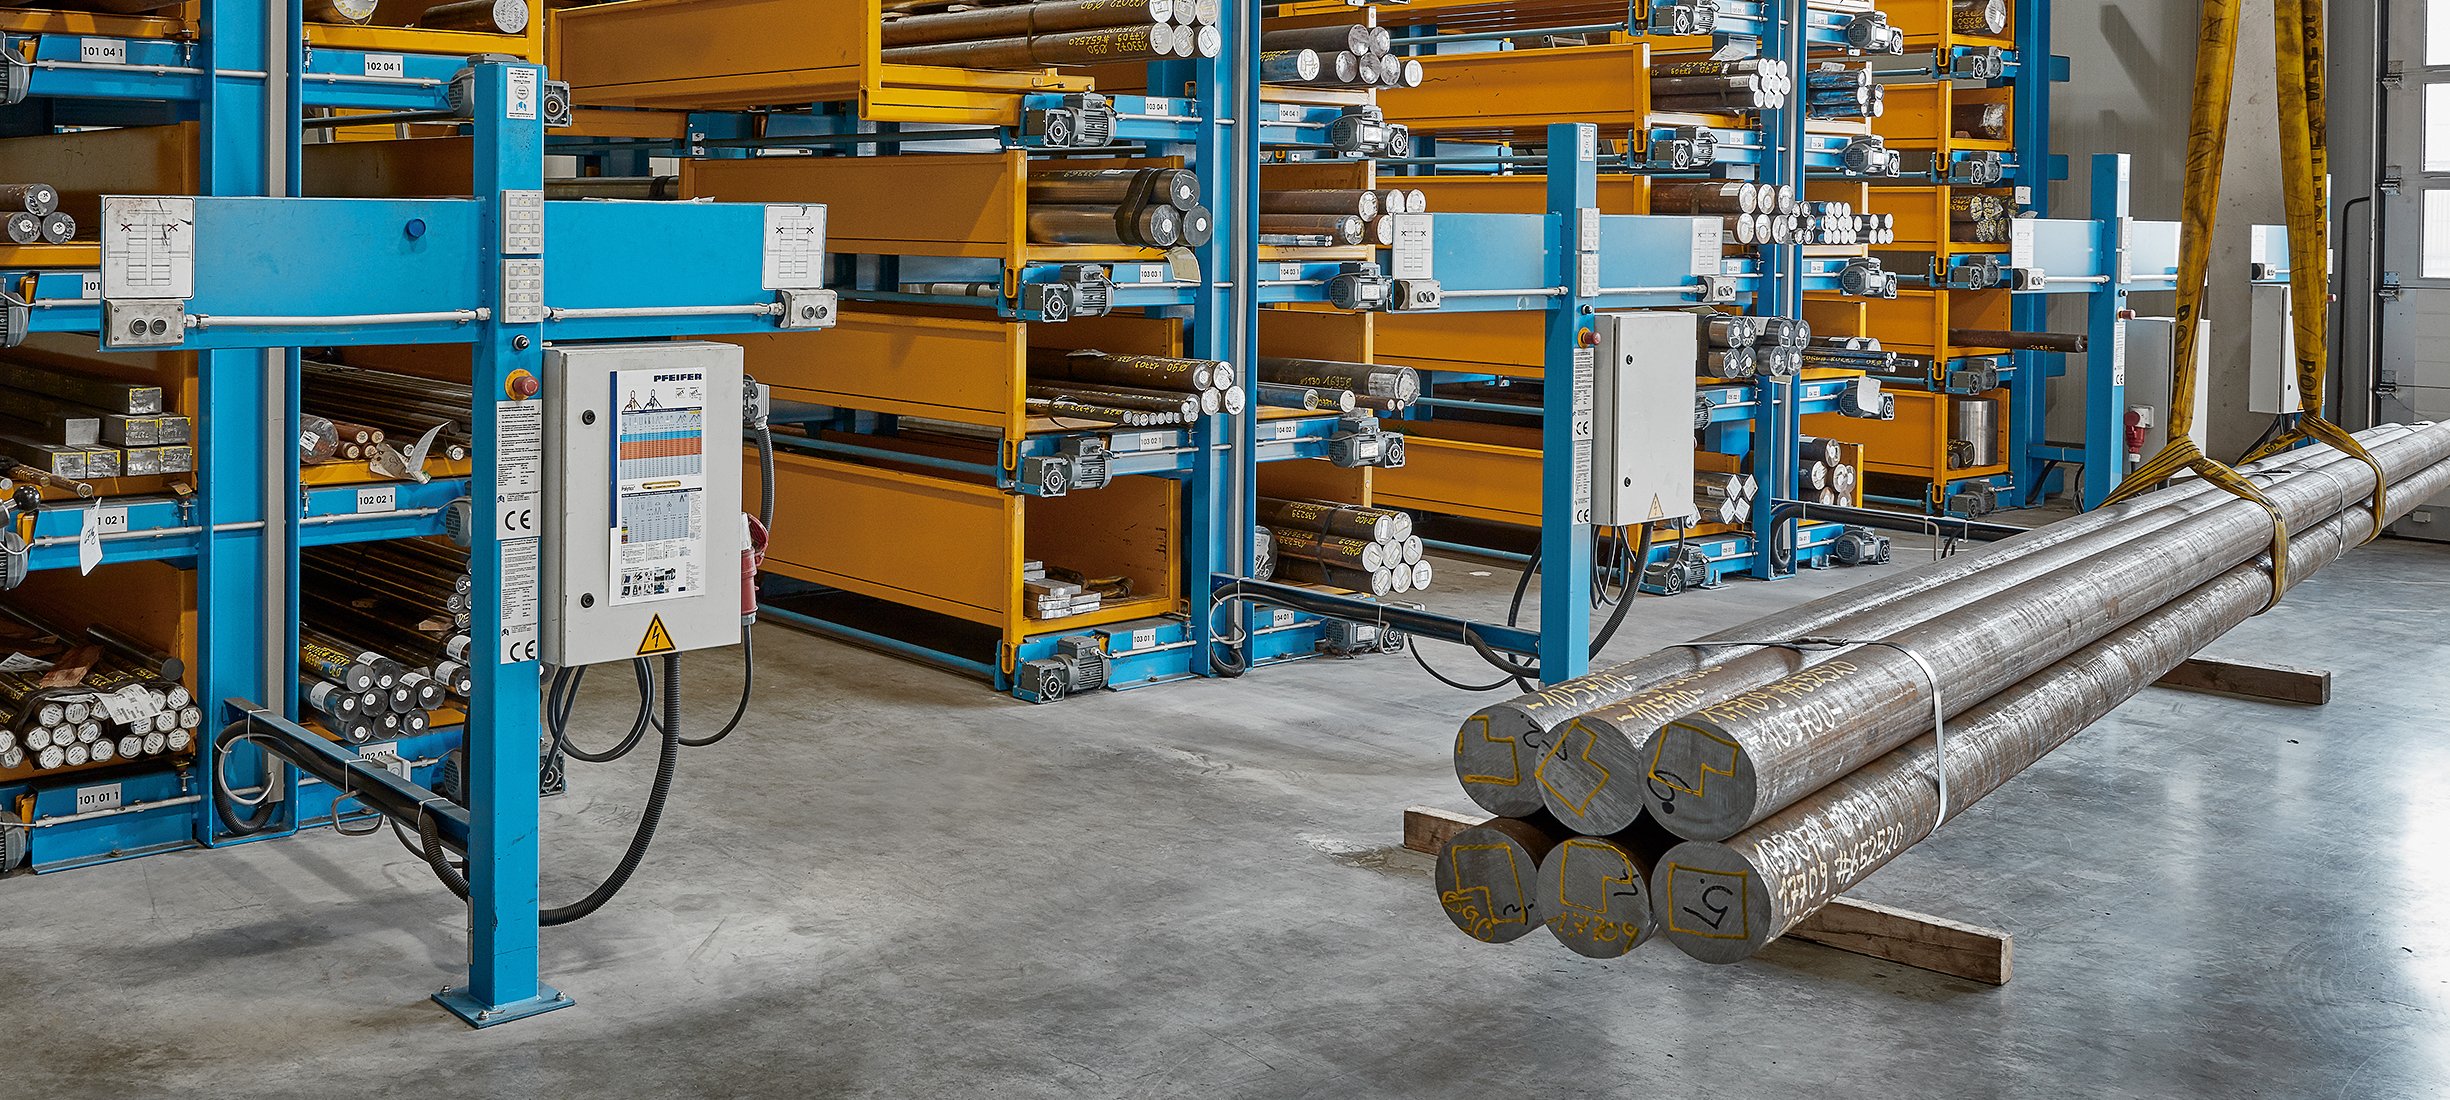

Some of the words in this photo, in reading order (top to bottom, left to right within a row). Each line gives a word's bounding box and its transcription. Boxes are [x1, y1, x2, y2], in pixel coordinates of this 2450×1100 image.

[83, 46, 99, 57] 101
[103, 47, 116, 58] 04
[119, 48, 123, 58] 1
[366, 61, 382, 71] 102
[384, 61, 396, 71] 04
[397, 62, 401, 72] 1
[653, 373, 702, 383] PFEIFER
[359, 496, 374, 505] 102
[376, 495, 387, 504] 02
[389, 494, 393, 502] 1
[105, 515, 117, 525] 02
[120, 515, 125, 523] 1
[505, 509, 531, 531] CE
[1577, 509, 1590, 523] CE
[510, 640, 536, 662] CE
[79, 795, 95, 805] 101
[98, 792, 110, 802] 01
[114, 791, 119, 800] 1
